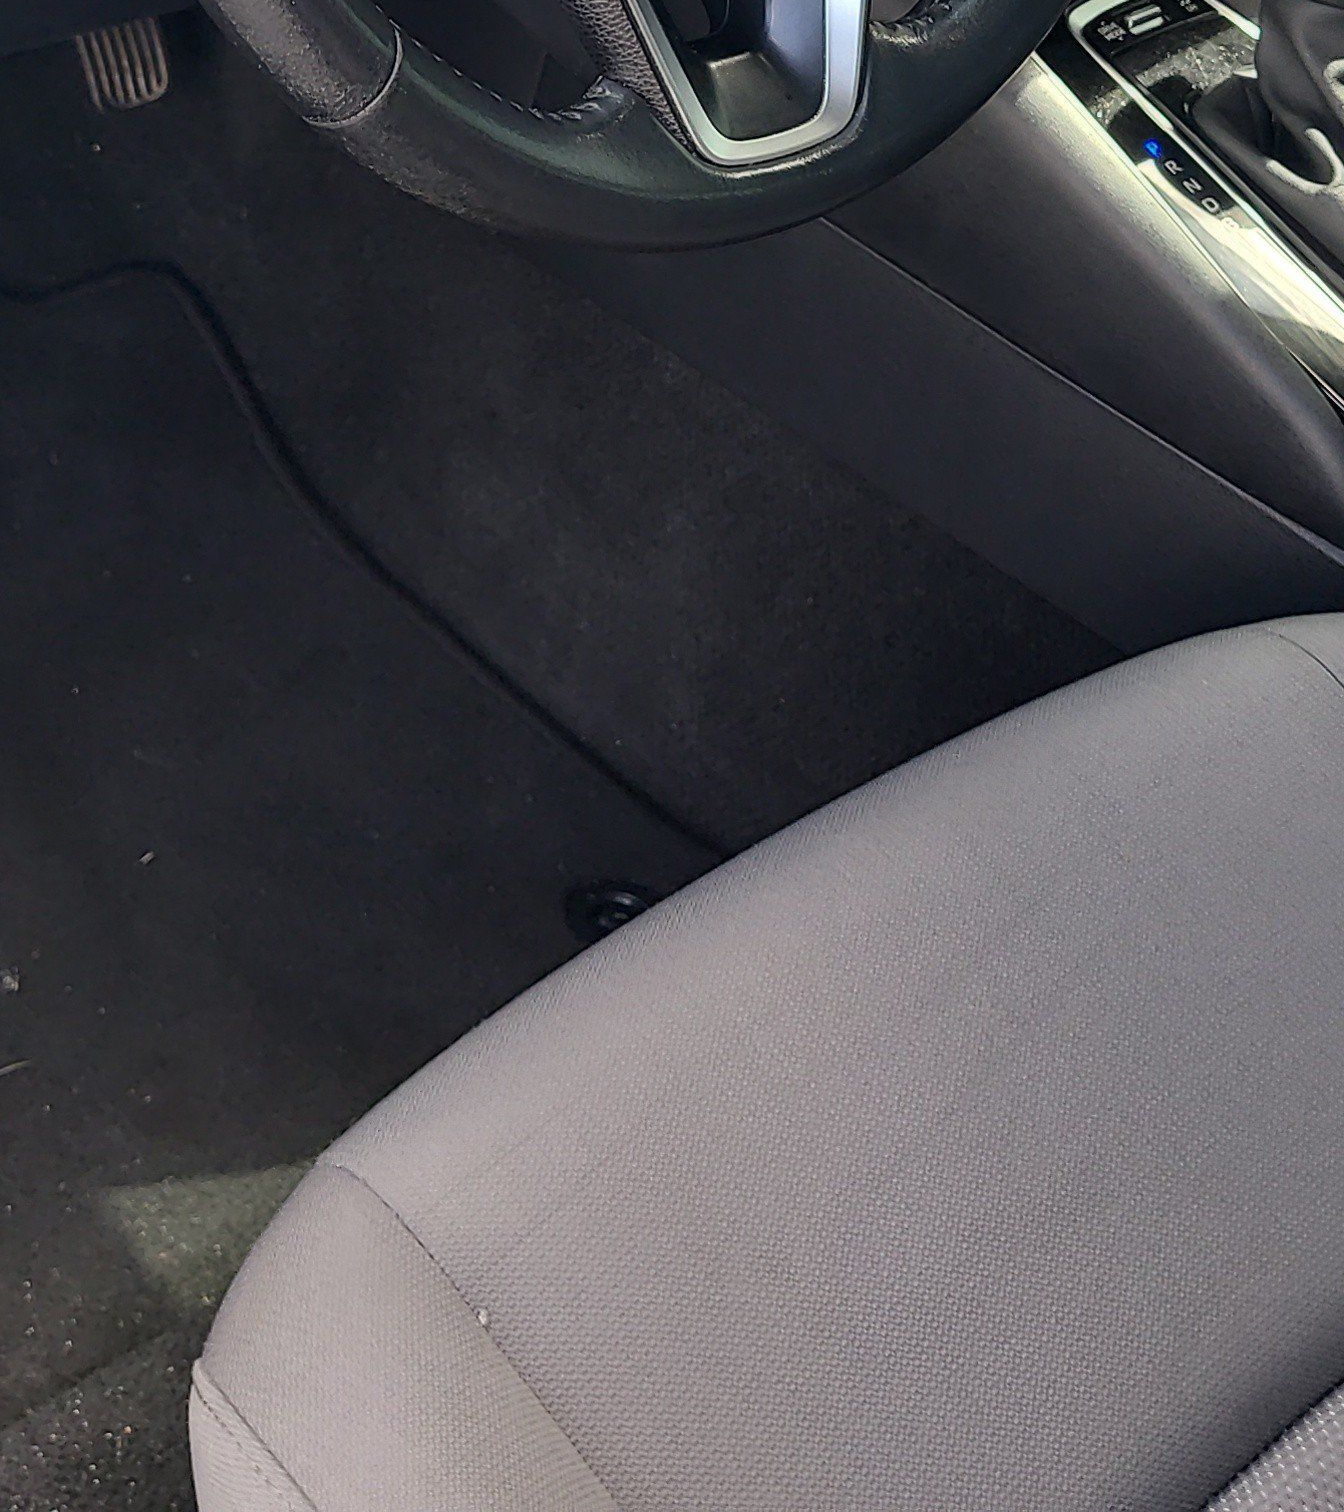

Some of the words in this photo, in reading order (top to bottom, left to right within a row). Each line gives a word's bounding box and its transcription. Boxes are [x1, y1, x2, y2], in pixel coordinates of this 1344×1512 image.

[1164, 159, 1184, 175] R
[1182, 177, 1203, 195] N
[1201, 196, 1221, 215] D
